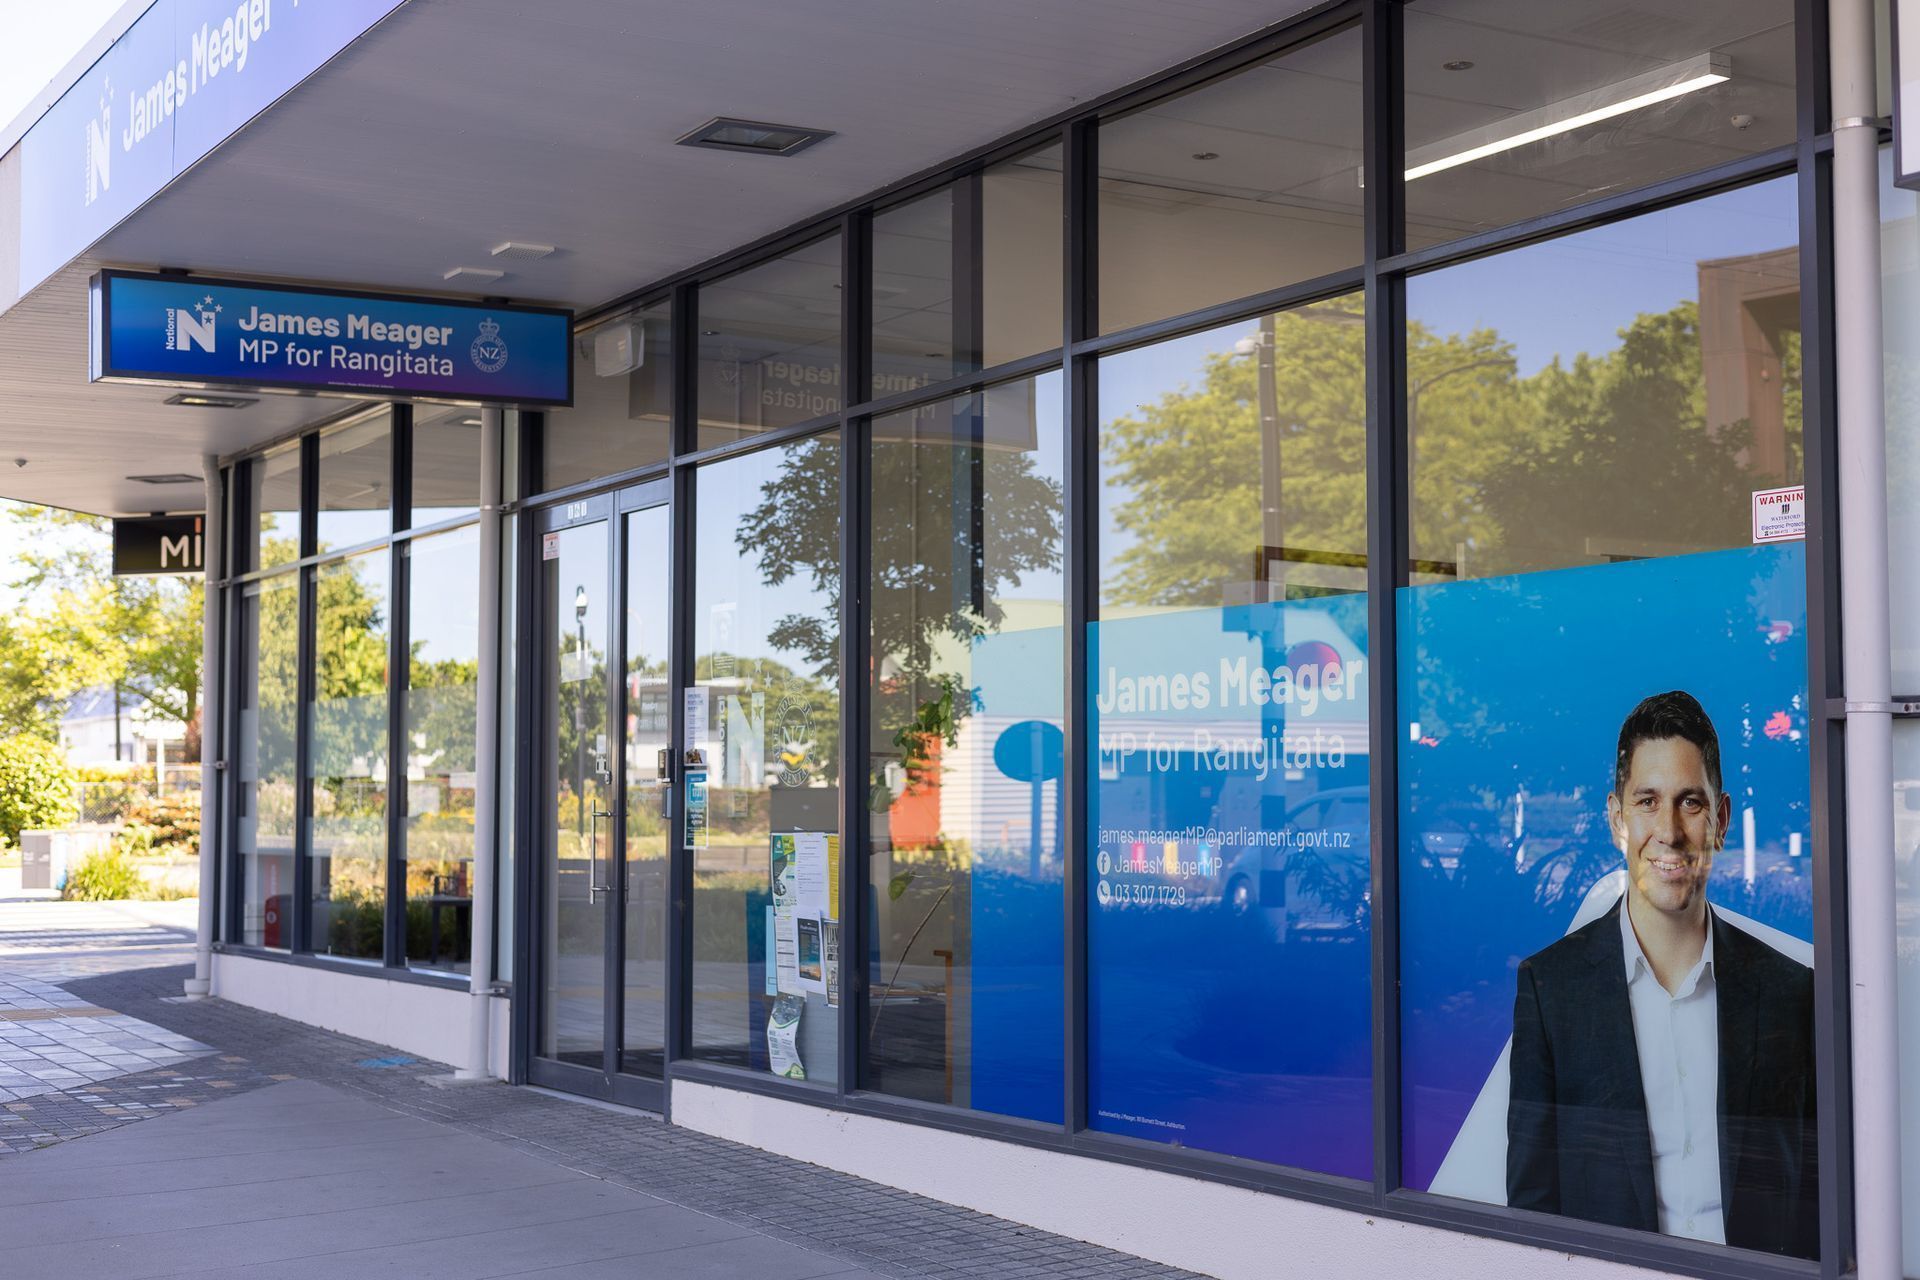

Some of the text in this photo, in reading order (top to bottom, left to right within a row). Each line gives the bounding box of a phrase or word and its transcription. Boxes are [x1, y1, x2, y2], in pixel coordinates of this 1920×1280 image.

[123, 69, 187, 151] James
[166, 308, 175, 350] National
[239, 306, 453, 349] James Meager
[239, 338, 278, 363] MP
[285, 342, 323, 367] for
[330, 345, 454, 377] Rangitata
[479, 346, 499, 359] NZ
[1760, 492, 1804, 505] WARNIN
[1096, 656, 1364, 717] James Meager
[1099, 725, 1346, 782] MP for Rangitata
[1097, 826, 1351, 852] james.meagerMP@parliament.govt.nz
[1115, 855, 1223, 880] JamesMeagerMP
[1115, 884, 1186, 905] 03 307 1729
